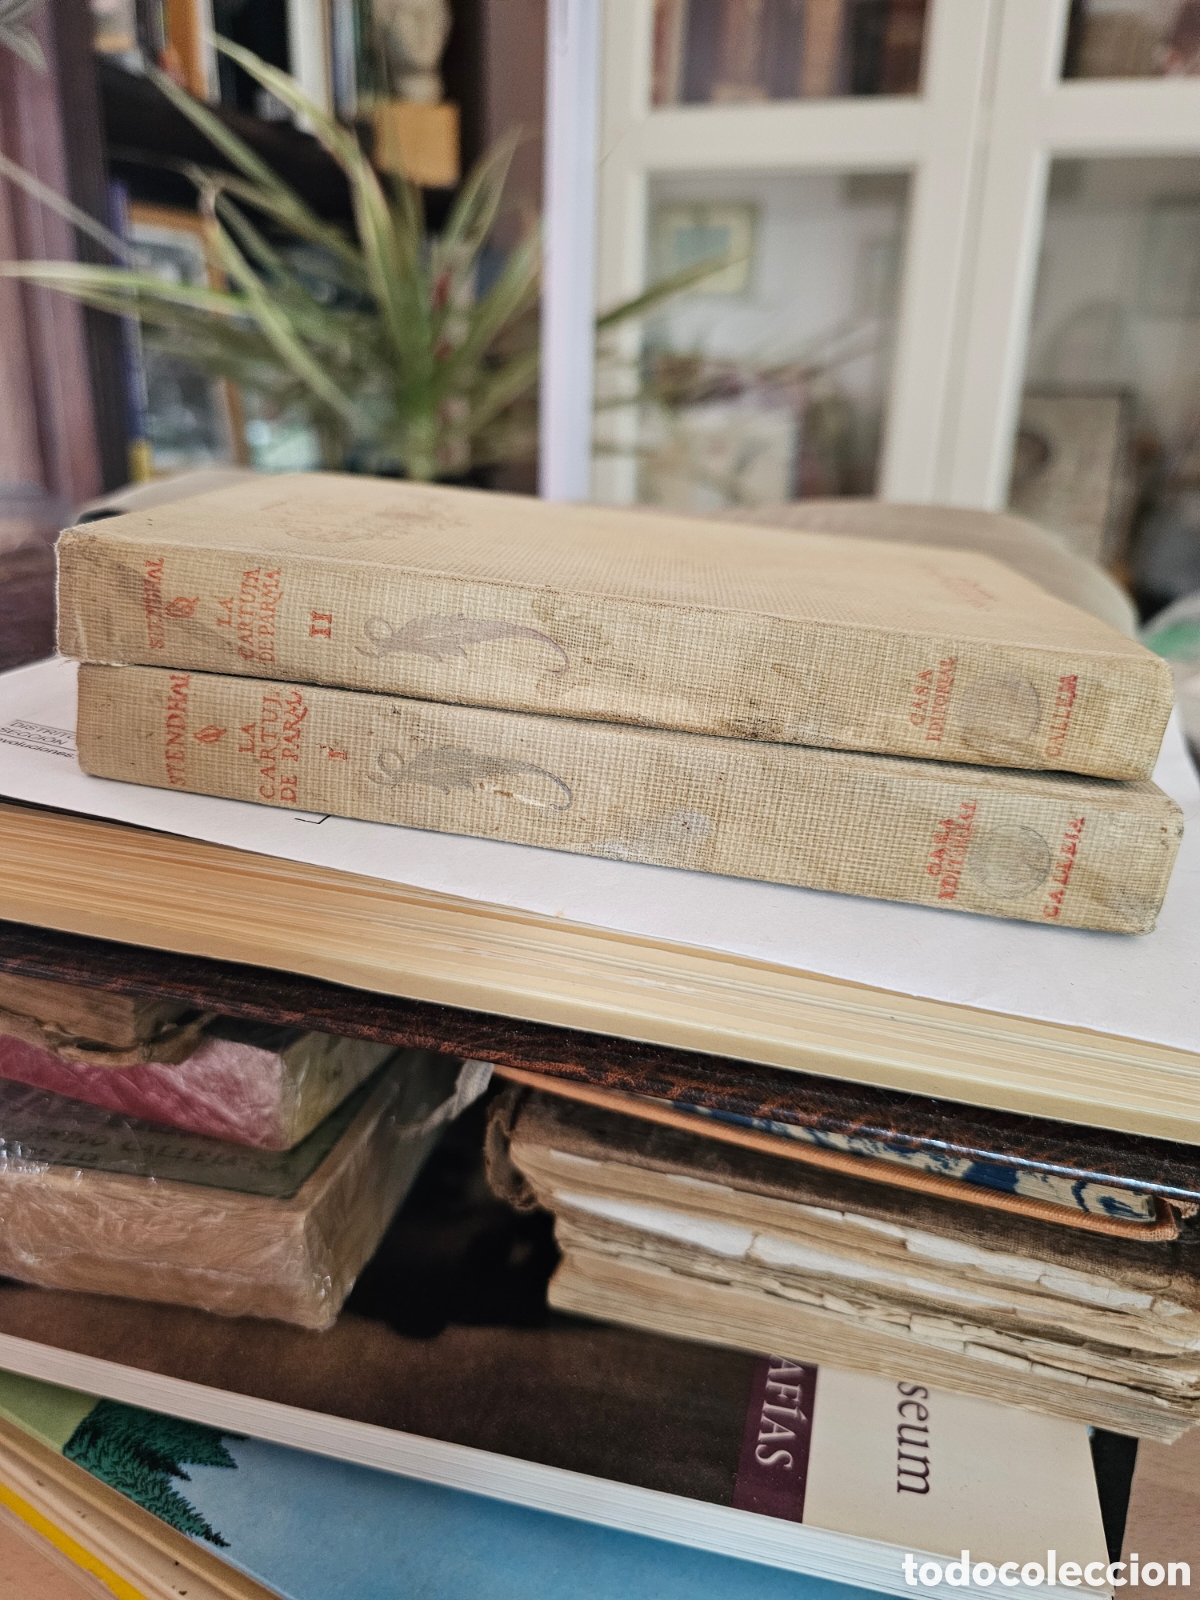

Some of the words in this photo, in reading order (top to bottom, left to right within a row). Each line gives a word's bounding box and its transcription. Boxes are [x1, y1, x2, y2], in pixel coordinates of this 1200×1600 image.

[216, 597, 235, 628] LA
[237, 566, 262, 661] CARTUJA
[258, 567, 284, 637] PARMA
[309, 610, 333, 639] II
[258, 639, 276, 663] DE
[910, 669, 934, 727] CASA
[165, 674, 191, 787] STENDHAL
[238, 722, 256, 754] LA
[279, 775, 297, 803] DE
